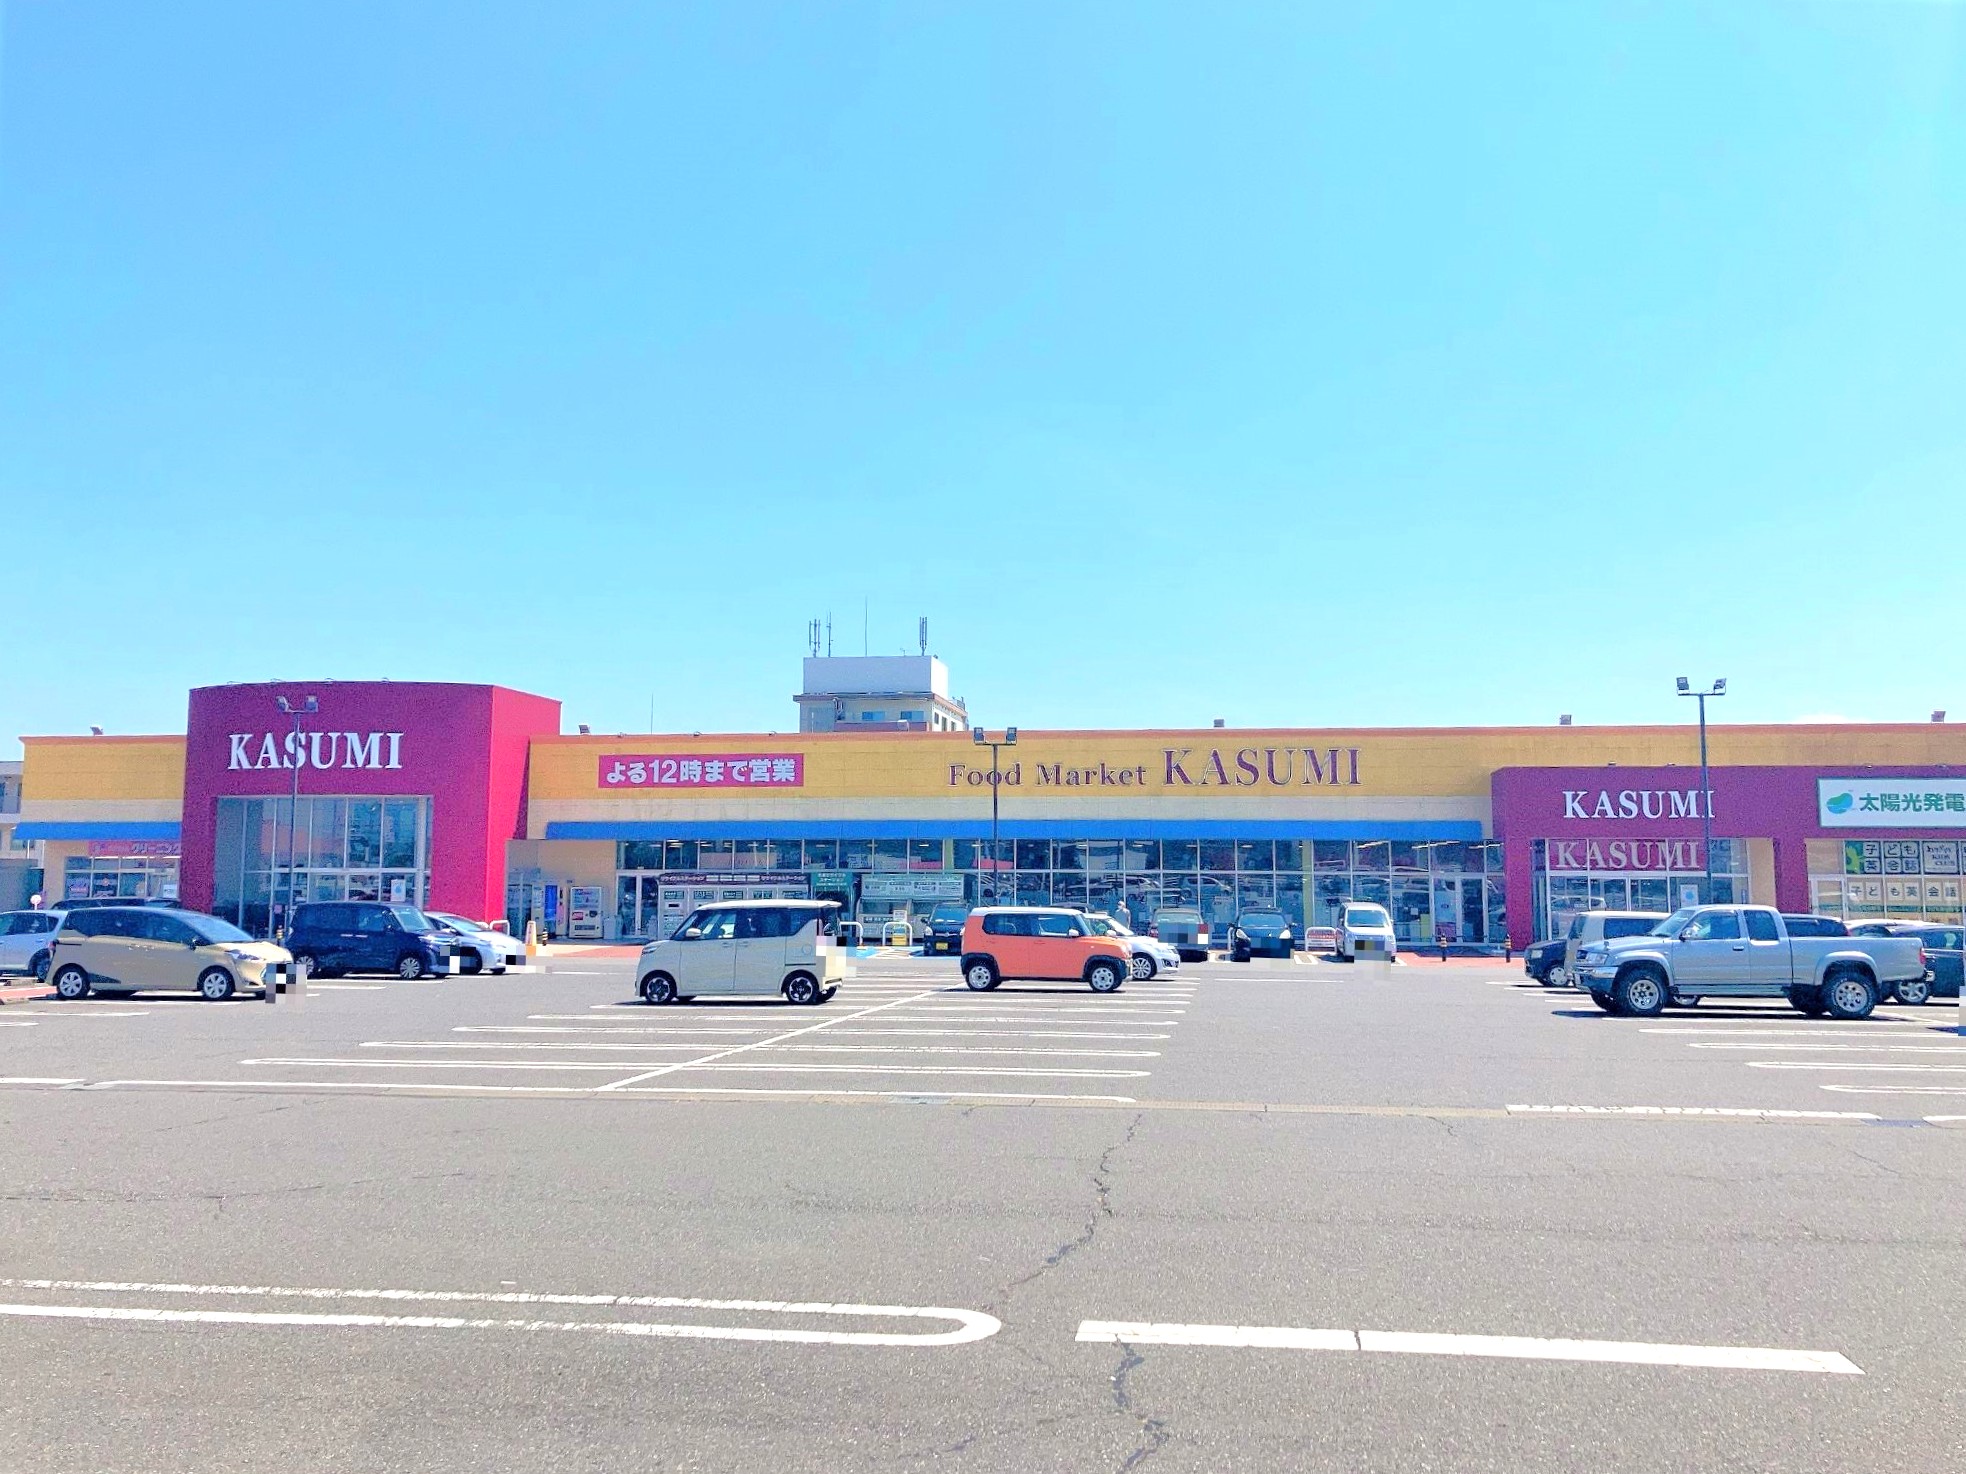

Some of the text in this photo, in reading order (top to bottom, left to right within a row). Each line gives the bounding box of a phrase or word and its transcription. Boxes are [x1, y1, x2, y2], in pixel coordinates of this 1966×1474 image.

[227, 730, 404, 770] KASUMI
[606, 757, 796, 784] よる12時まで営業
[947, 747, 1363, 787] Food Market KASUMI
[1561, 789, 1716, 819] KASUMI
[1858, 792, 1966, 812] 太陽光発電
[1555, 841, 1700, 869] KASUMI
